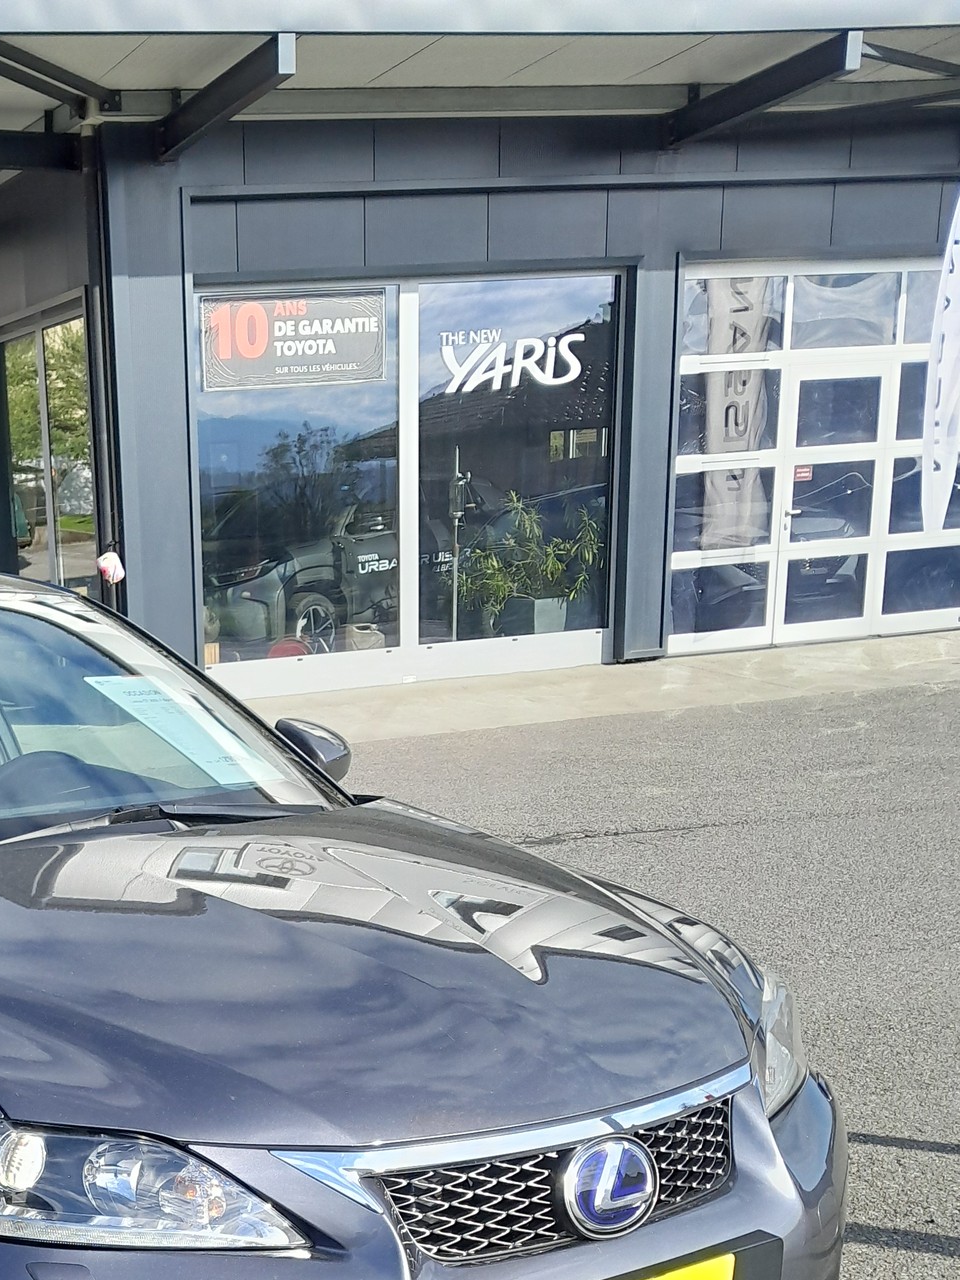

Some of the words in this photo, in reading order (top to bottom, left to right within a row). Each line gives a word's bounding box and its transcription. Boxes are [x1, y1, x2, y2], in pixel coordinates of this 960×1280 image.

[273, 299, 307, 317] ANS
[211, 301, 268, 360] 10
[273, 320, 296, 337] DE
[298, 316, 378, 335] GARANTIE
[440, 331, 466, 346] THE
[469, 328, 502, 344] NEW
[273, 339, 336, 357] TOYOTA
[275, 366, 289, 374] SUR
[290, 365, 308, 373] TOUS
[309, 364, 321, 372] LES
[357, 553, 379, 562] TOYOTA
[358, 558, 398, 574] URBA
